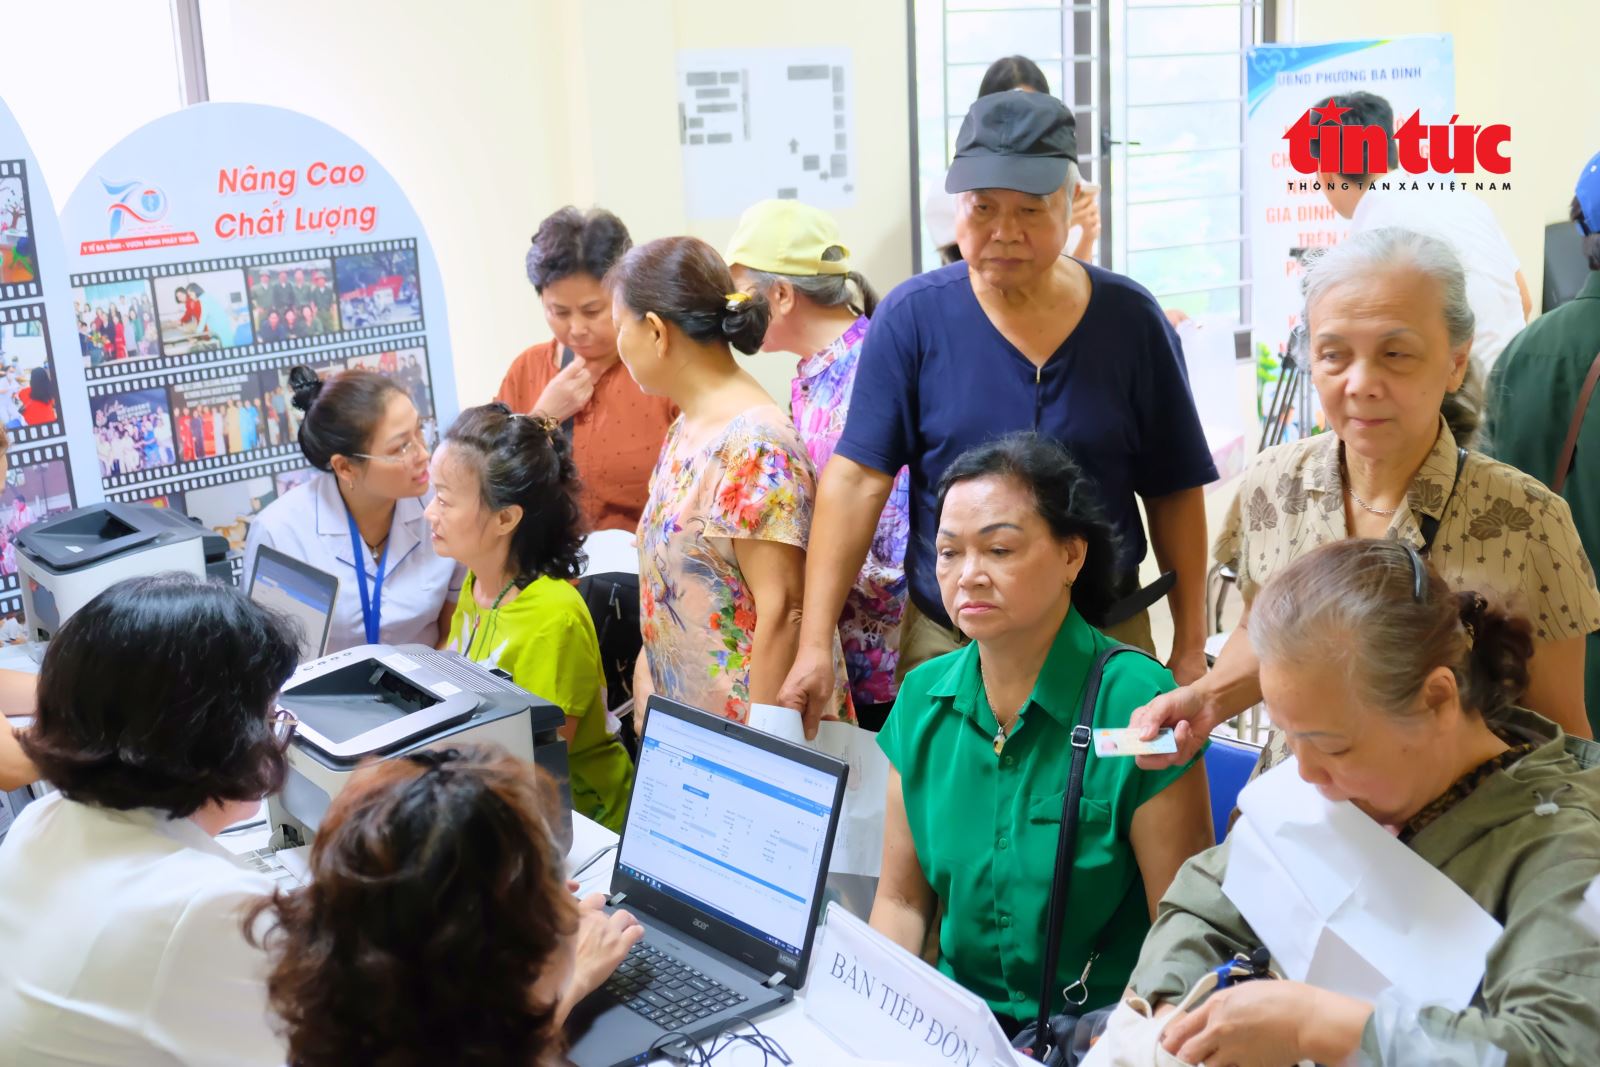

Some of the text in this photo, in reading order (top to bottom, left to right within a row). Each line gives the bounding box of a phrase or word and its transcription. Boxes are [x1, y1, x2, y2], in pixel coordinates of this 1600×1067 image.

[1278, 73, 1311, 86] UBND
[1371, 68, 1387, 81] BA
[218, 161, 366, 197] Nâng Cao
[214, 200, 377, 239] Chất Lượng
[1266, 207, 1292, 224] GIA
[692, 918, 710, 931] acer
[830, 952, 979, 1067] BÀN TIẾP ĐÓN
